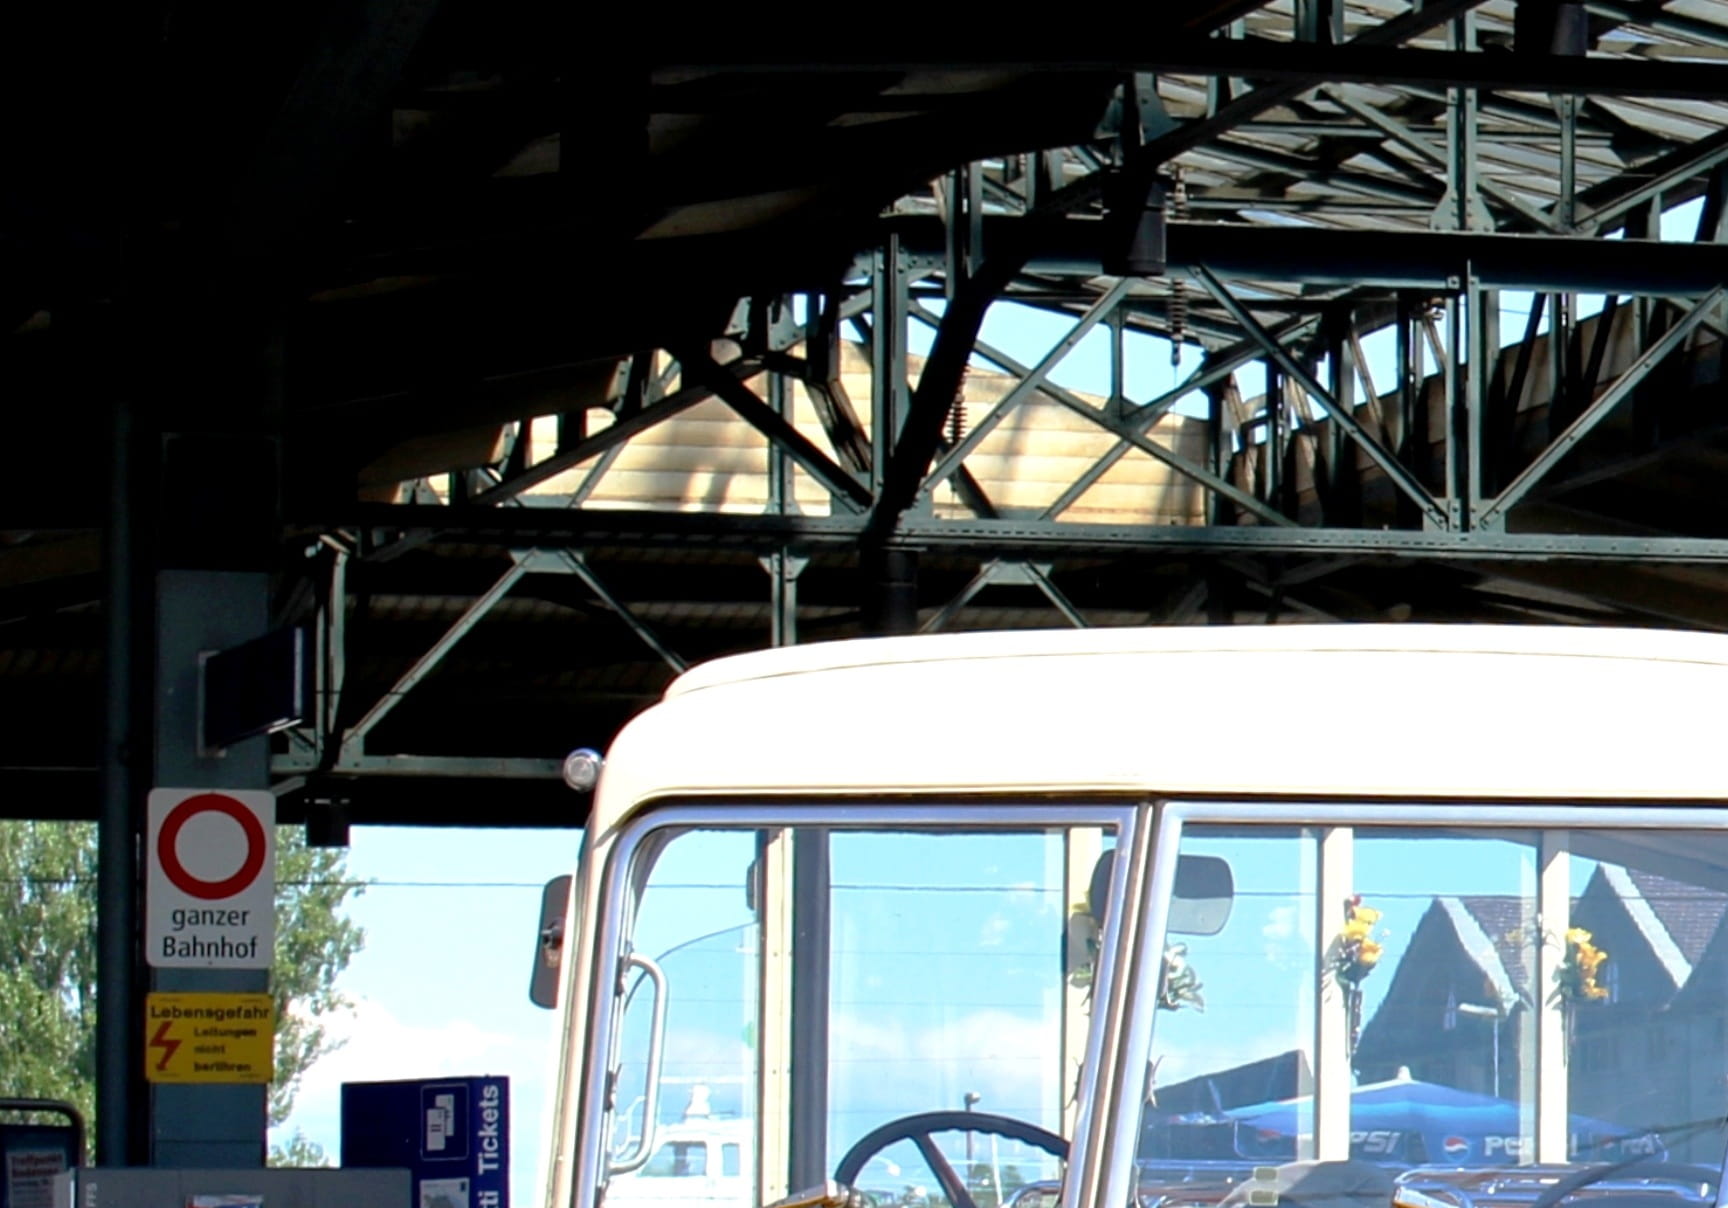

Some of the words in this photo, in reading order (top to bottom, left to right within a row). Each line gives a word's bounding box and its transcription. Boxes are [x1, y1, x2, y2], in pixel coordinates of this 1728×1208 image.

[172, 906, 249, 929] ganzer
[162, 934, 257, 959] Bahnhof
[151, 1005, 270, 1022] Lebensgefahr
[194, 1026, 257, 1039] Leitungen
[194, 1044, 226, 1055] nicht
[194, 1061, 252, 1072] berühren
[478, 1085, 498, 1175] Tickets
